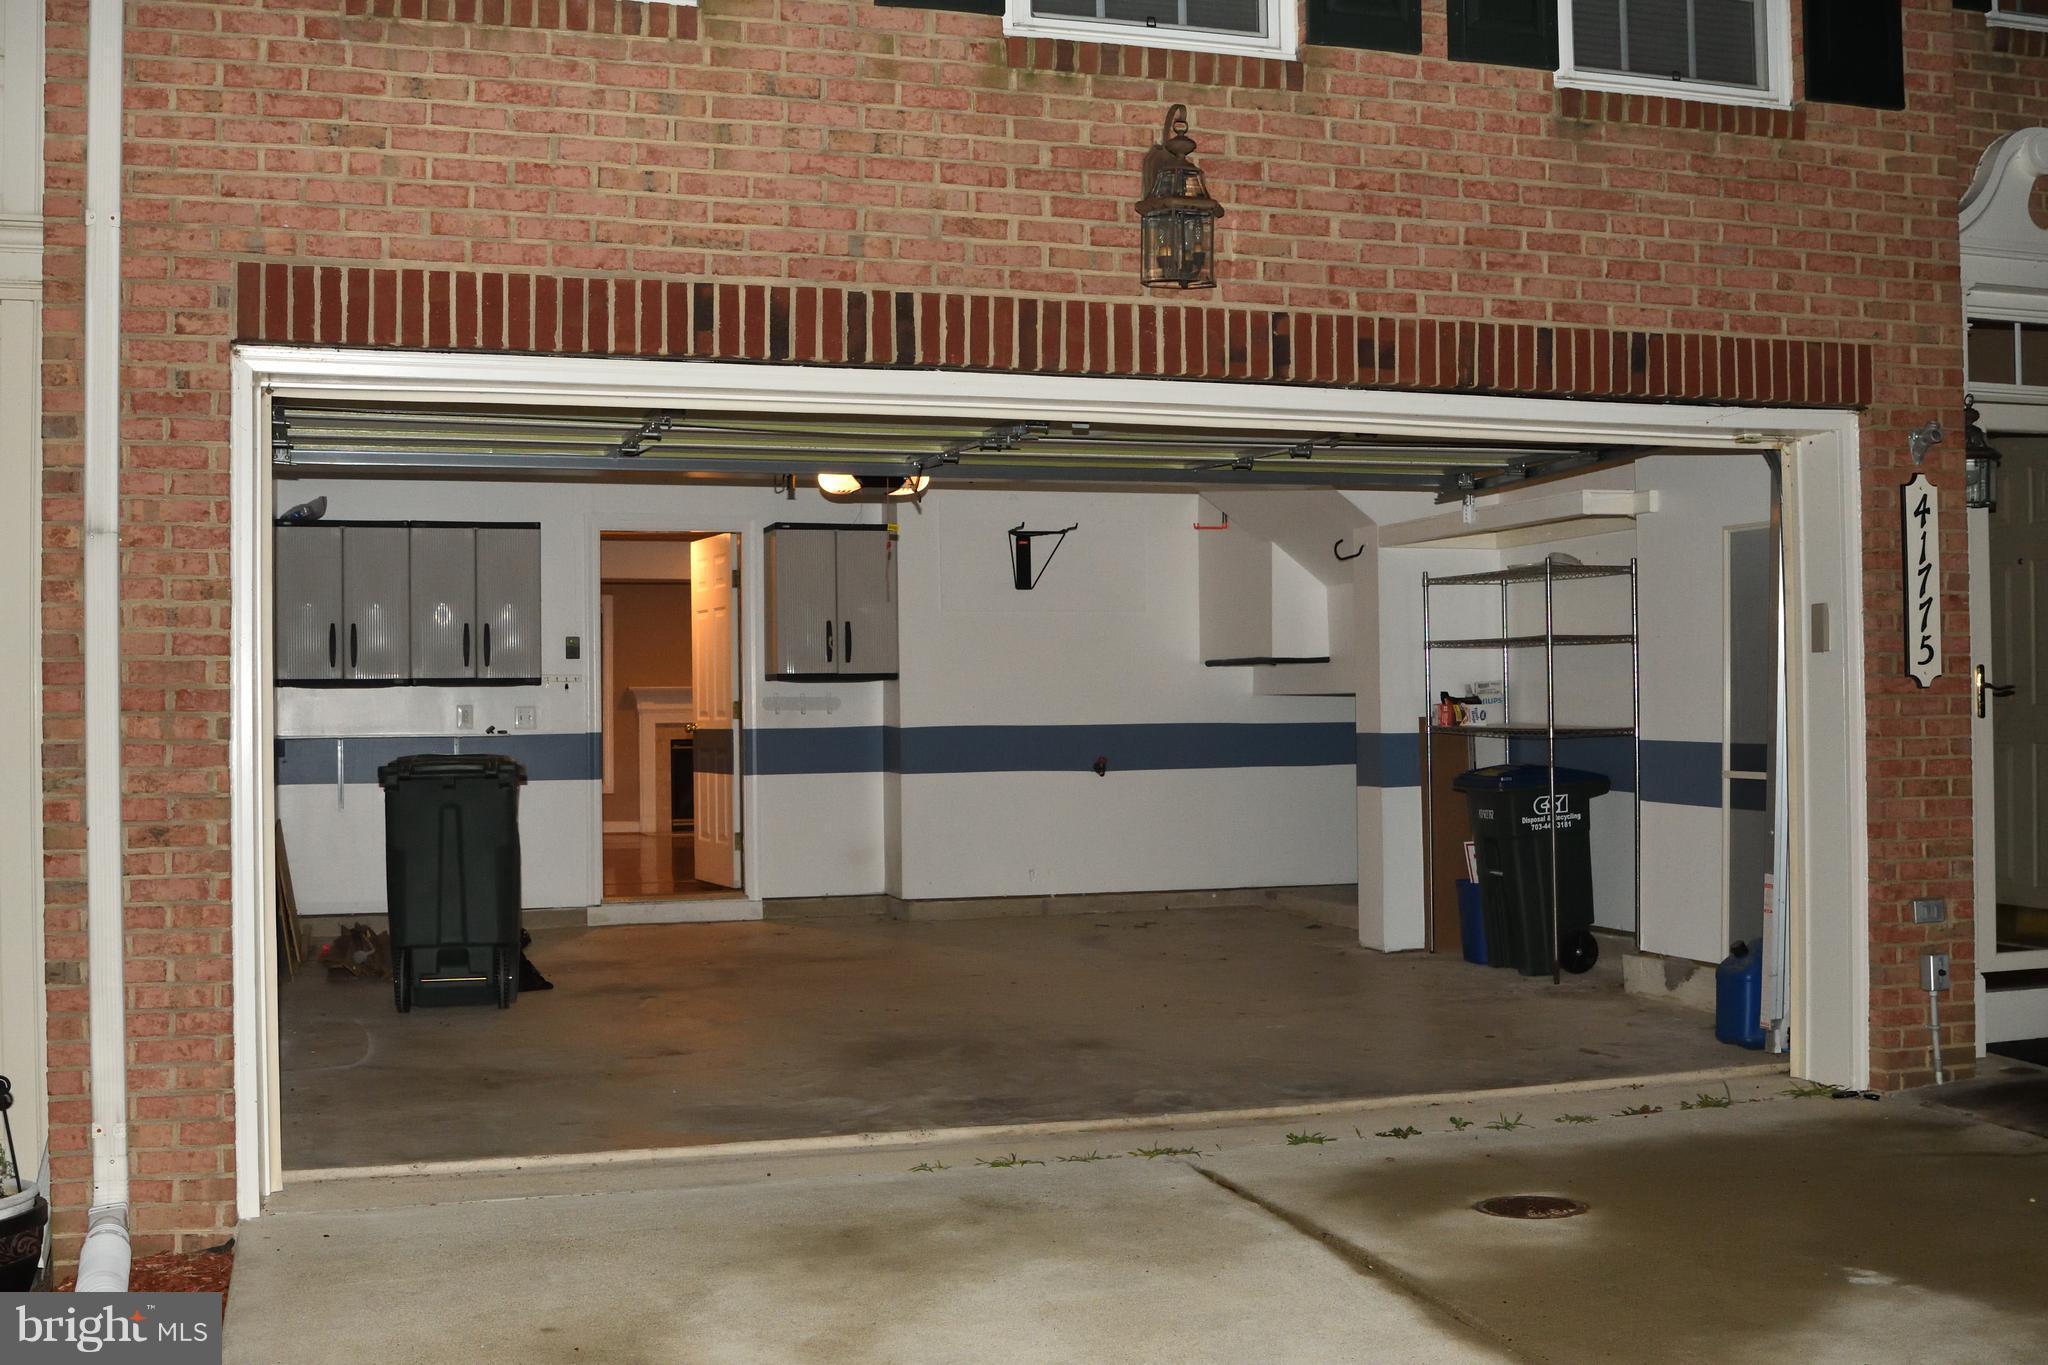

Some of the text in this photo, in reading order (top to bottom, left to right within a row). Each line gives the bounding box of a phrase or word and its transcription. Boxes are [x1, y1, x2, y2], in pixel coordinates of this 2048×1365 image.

[1914, 493, 1935, 666] 41775
[1521, 815, 1546, 825] Disposal
[1555, 812, 1582, 822] ecycling
[1531, 820, 1572, 831] 703-443181
